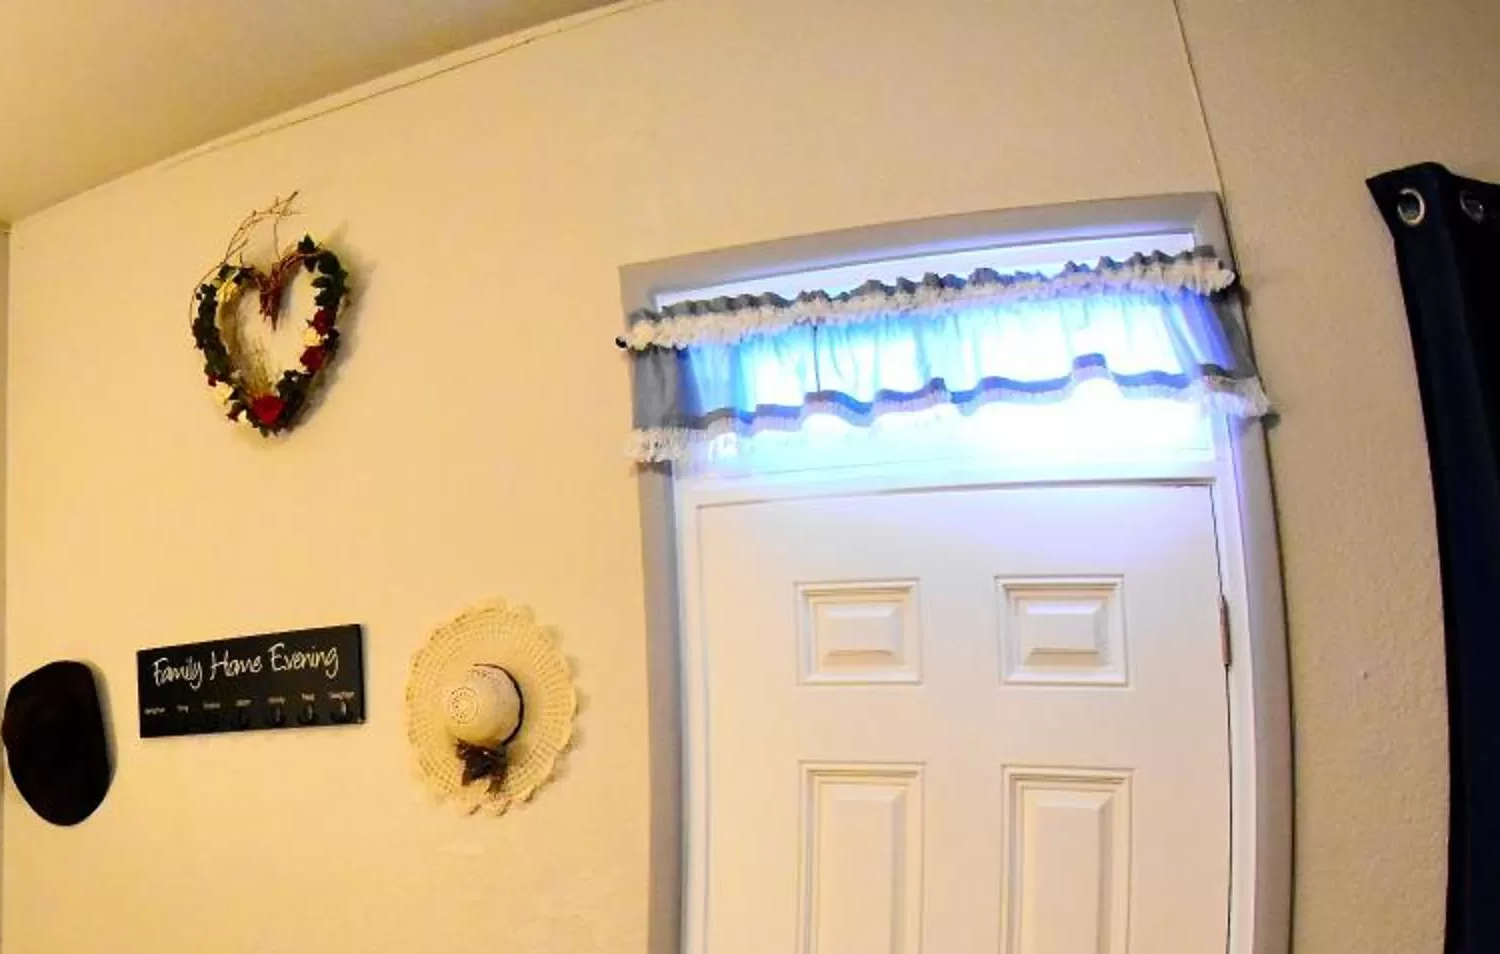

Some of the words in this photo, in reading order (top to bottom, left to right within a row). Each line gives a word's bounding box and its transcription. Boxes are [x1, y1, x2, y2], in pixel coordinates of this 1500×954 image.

[153, 656, 203, 691] Family
[209, 649, 263, 681] Home
[268, 642, 339, 679] Evening
